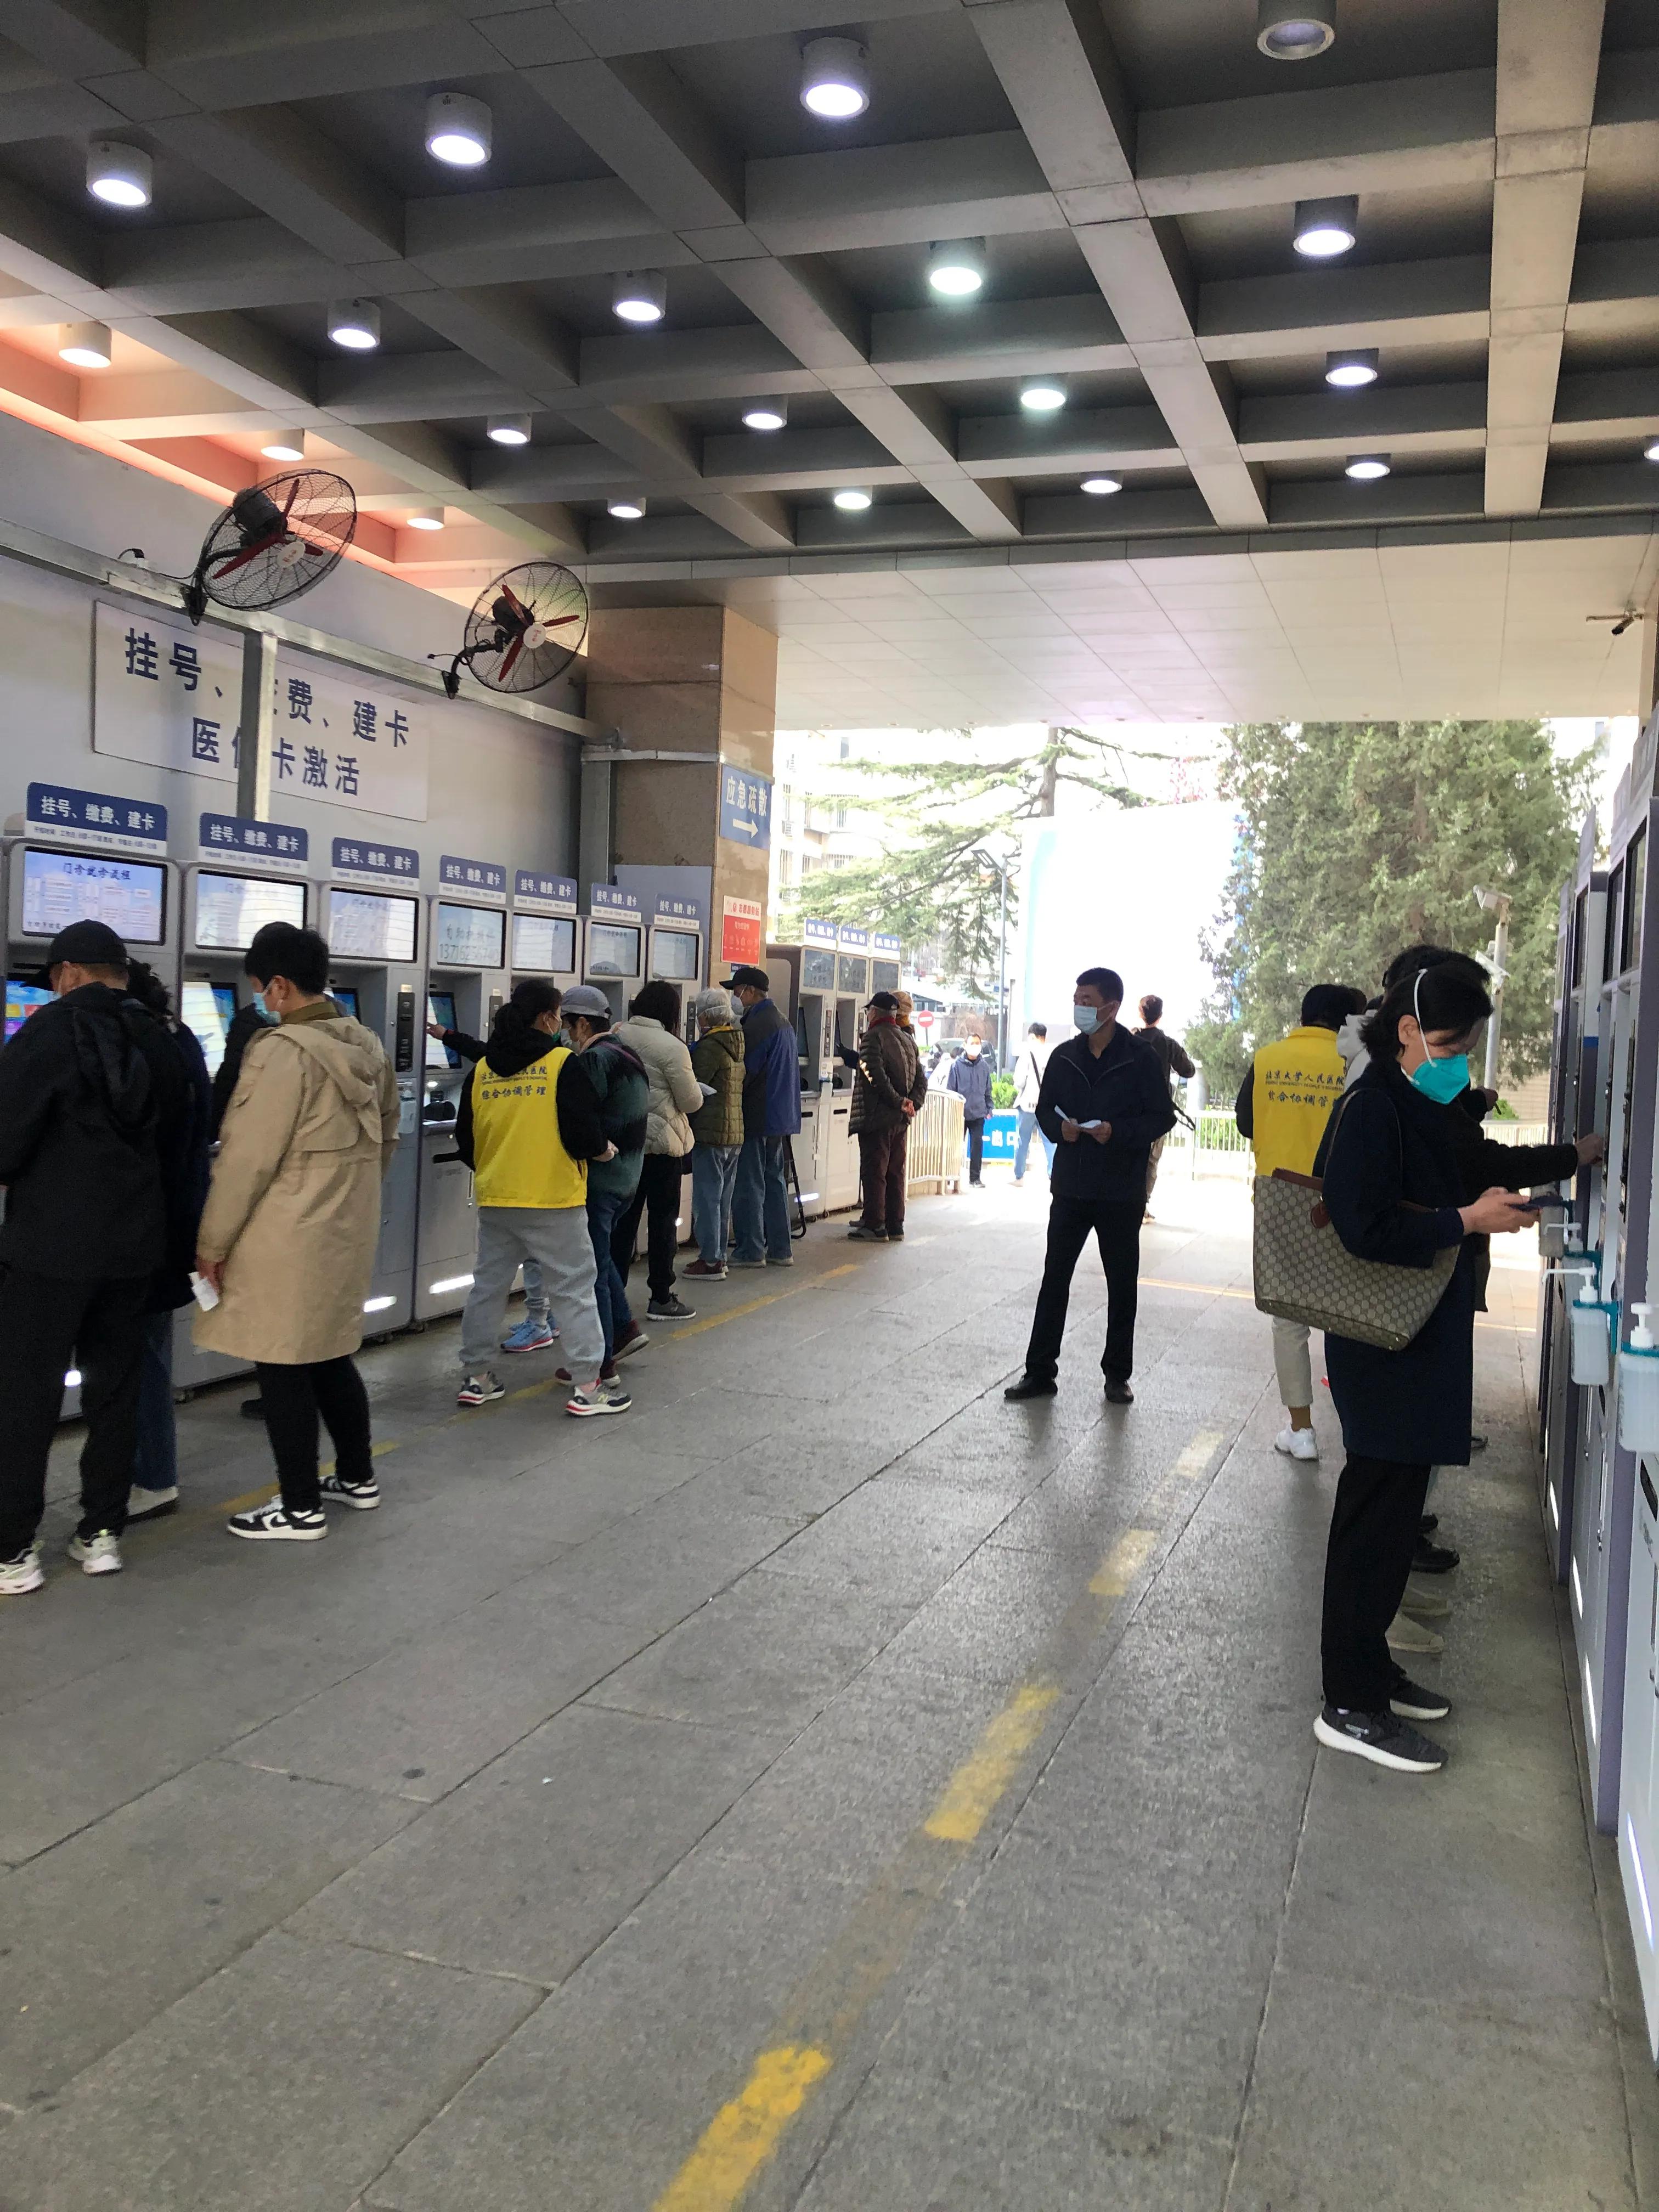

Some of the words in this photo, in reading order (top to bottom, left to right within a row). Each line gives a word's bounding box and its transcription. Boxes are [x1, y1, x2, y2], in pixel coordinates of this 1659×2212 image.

[125, 628, 409, 748] 挂号、费、建卡
[41, 795, 155, 831] 挂号、缴费、建卡
[726, 775, 768, 817] 应急疏散
